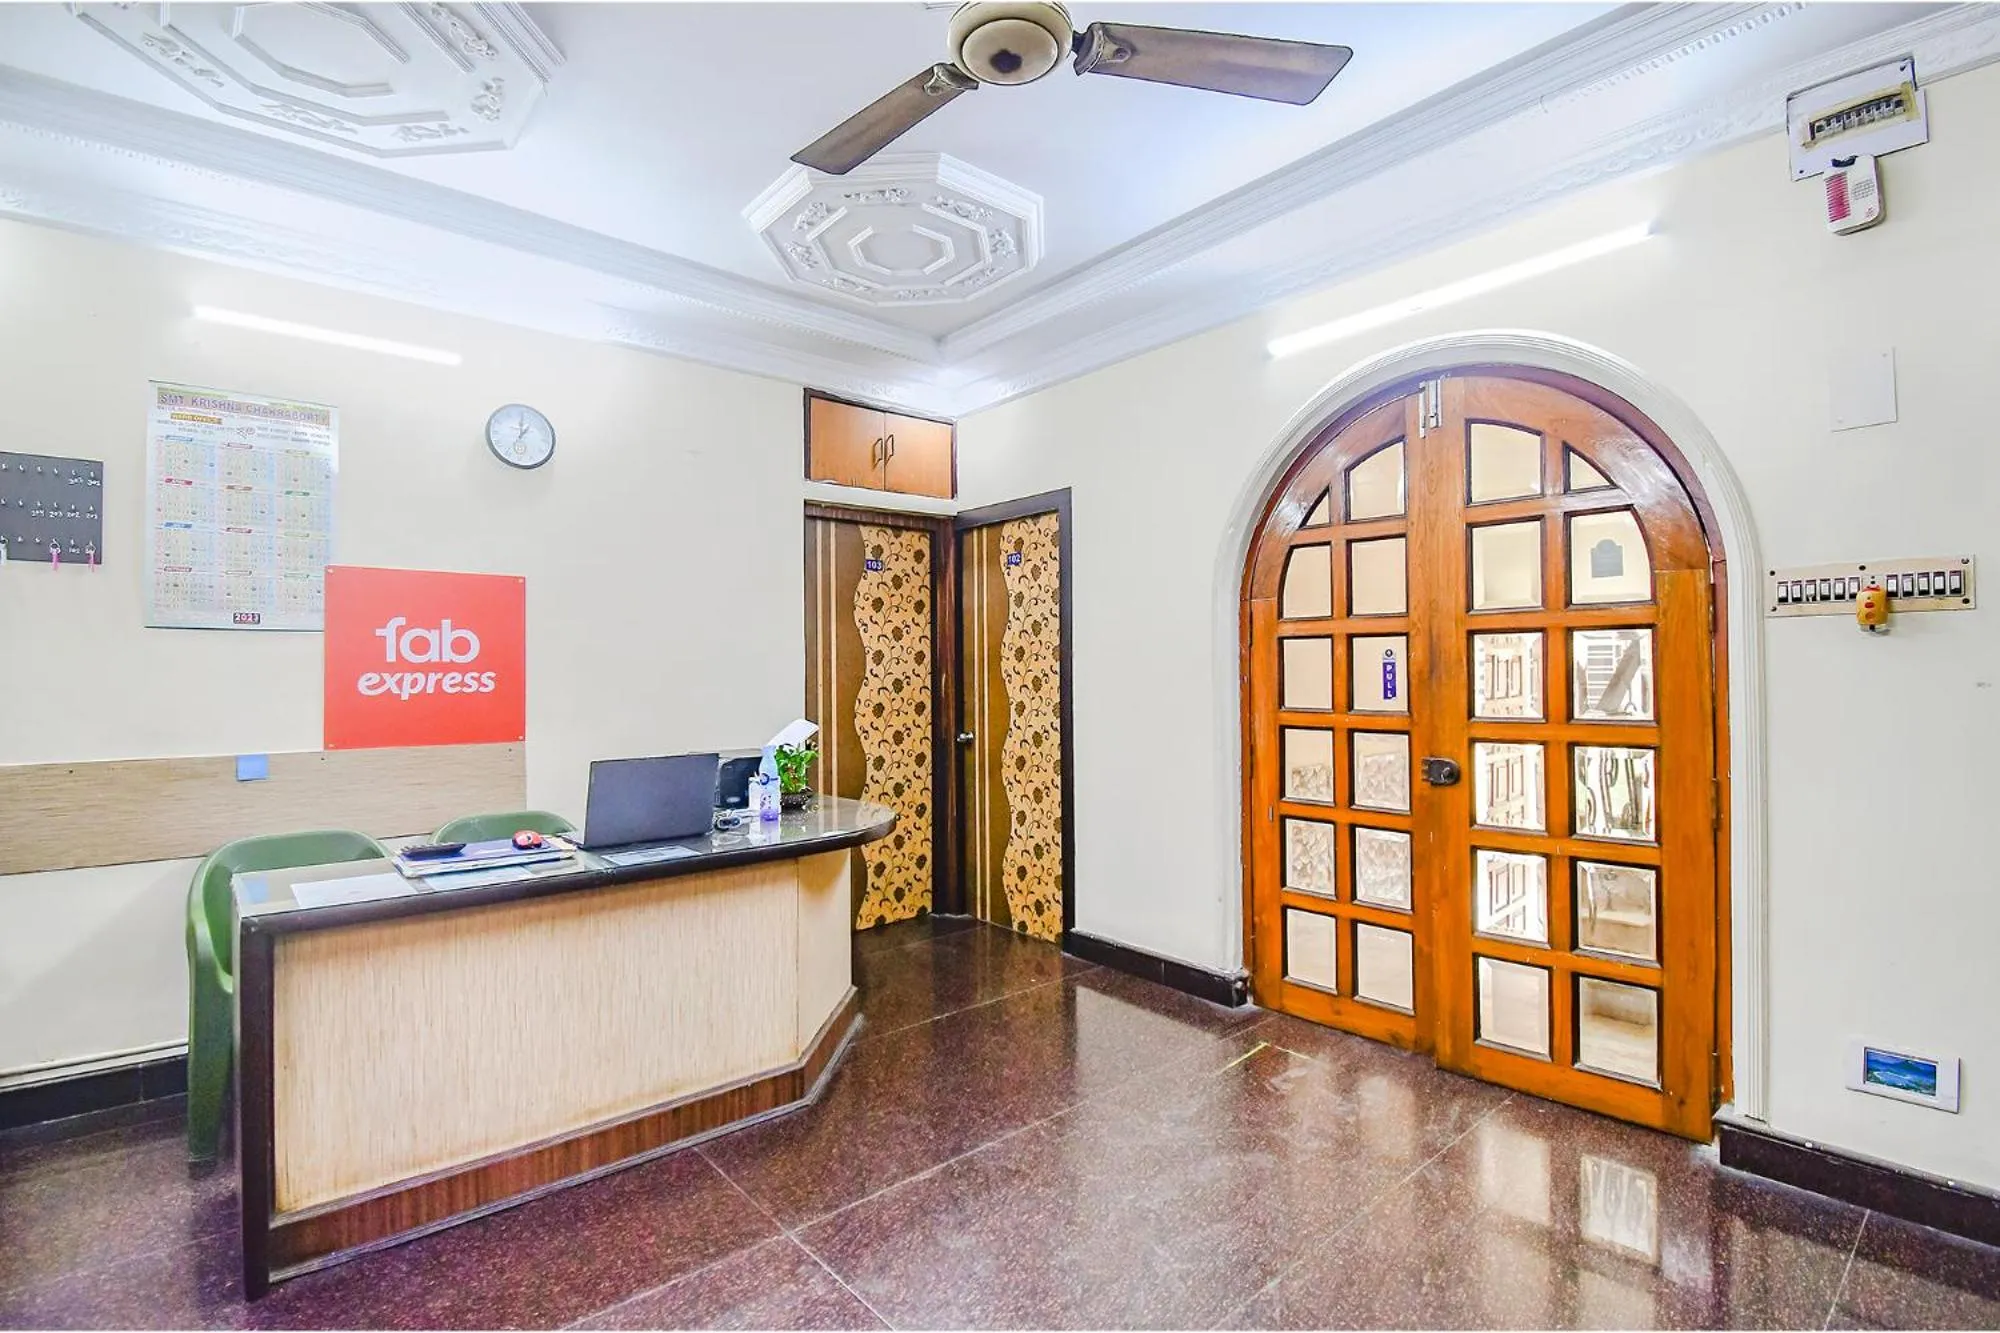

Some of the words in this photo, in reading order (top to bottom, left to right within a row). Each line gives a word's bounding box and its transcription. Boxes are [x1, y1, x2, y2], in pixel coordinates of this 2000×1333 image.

[160, 393, 184, 405] SMT
[191, 397, 242, 413] KRISHNA
[867, 560, 882, 570] 103
[375, 616, 481, 664] fab
[357, 671, 497, 701] express
